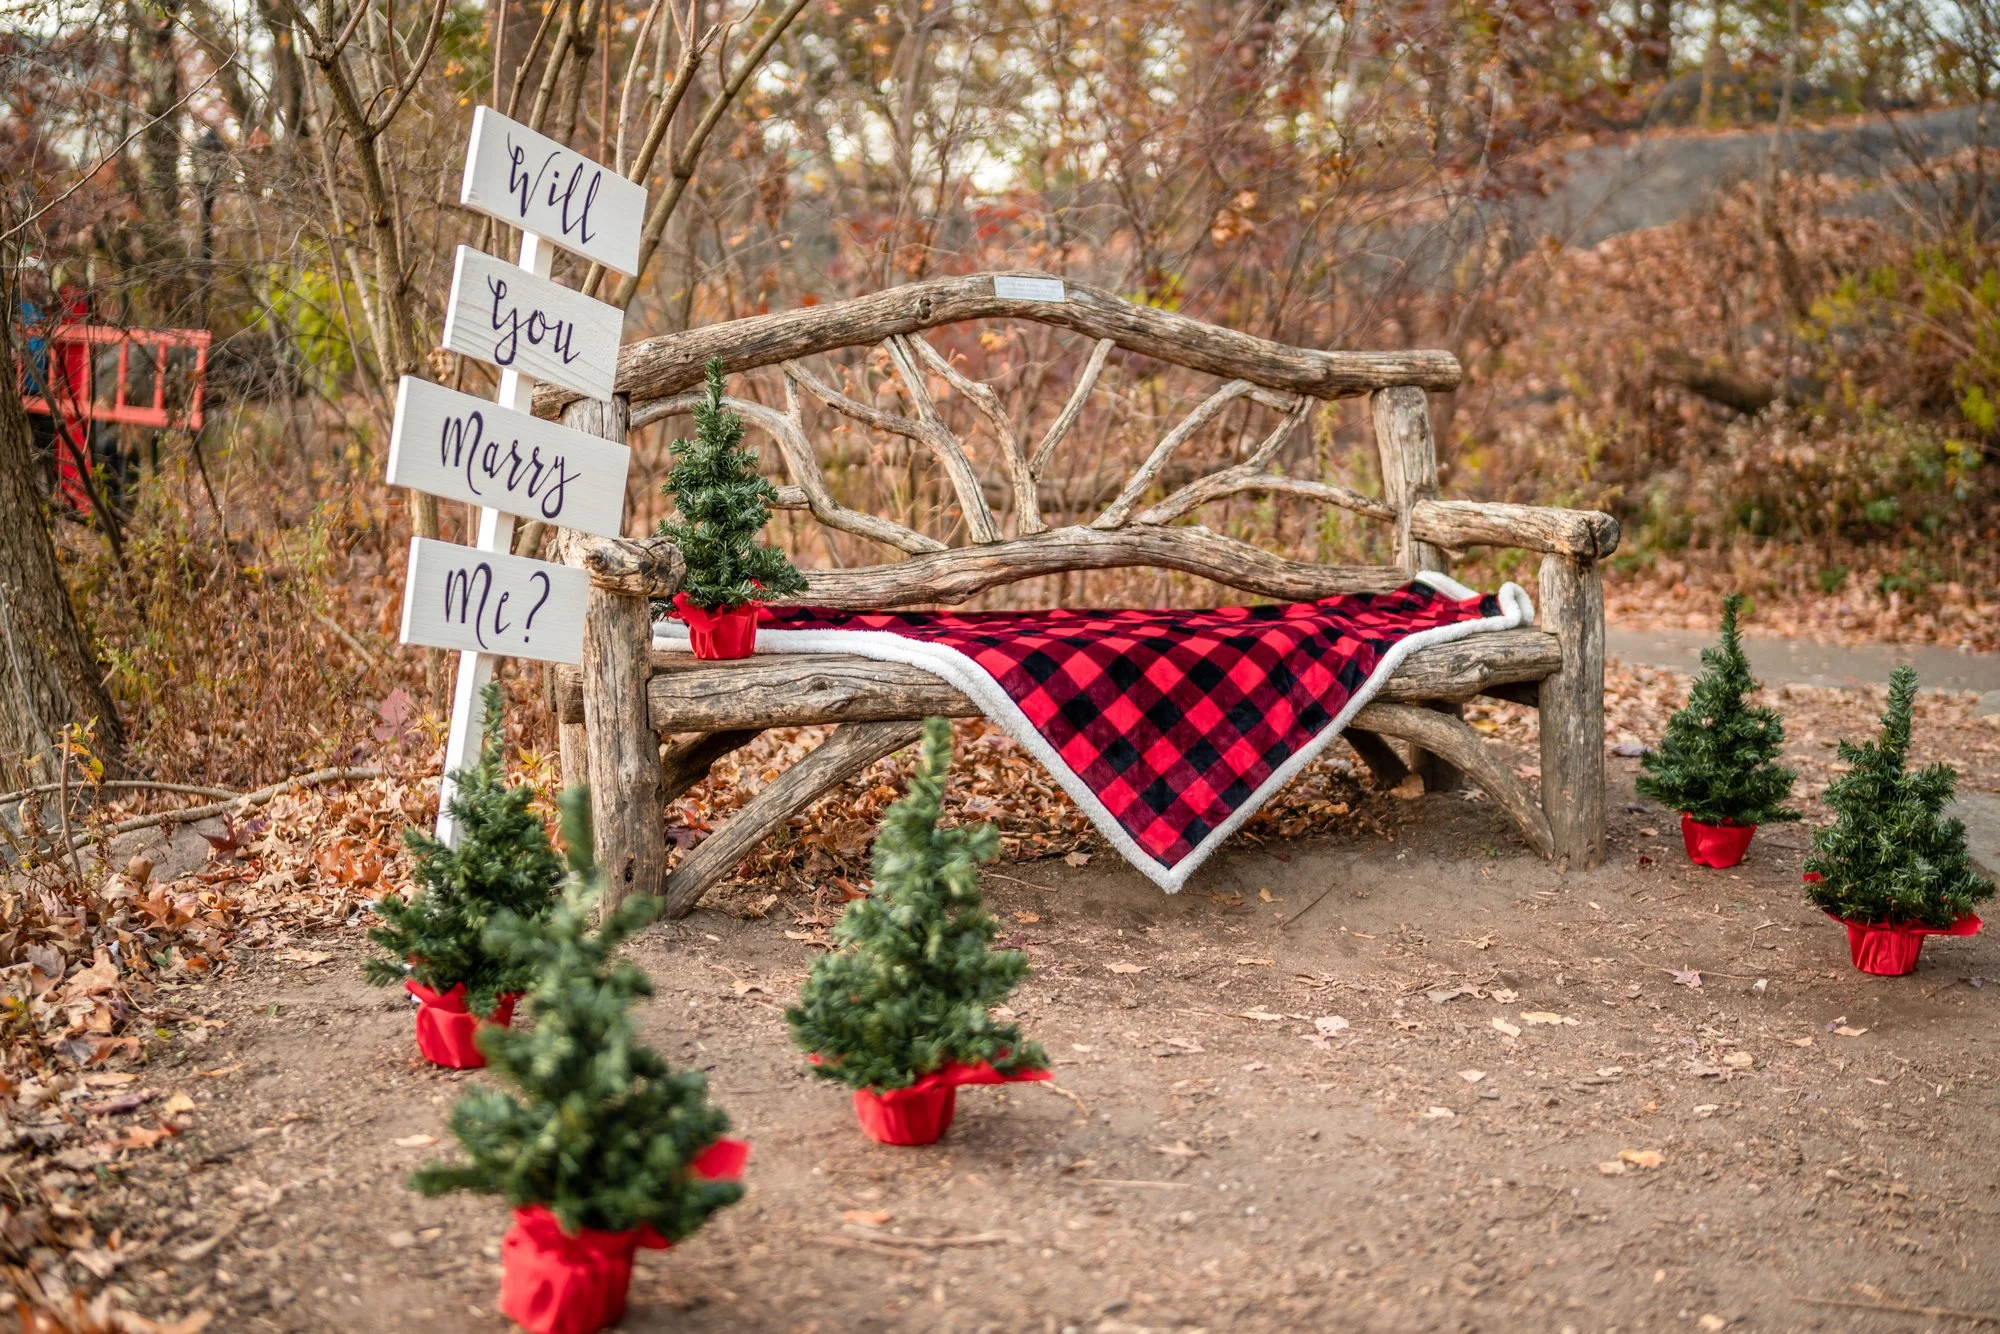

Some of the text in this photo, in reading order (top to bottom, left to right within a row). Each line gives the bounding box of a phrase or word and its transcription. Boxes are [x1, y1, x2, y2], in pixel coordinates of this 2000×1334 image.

[507, 132, 603, 244] Will
[487, 274, 581, 366] You
[440, 410, 581, 519] Marry
[444, 561, 550, 650] Me?
